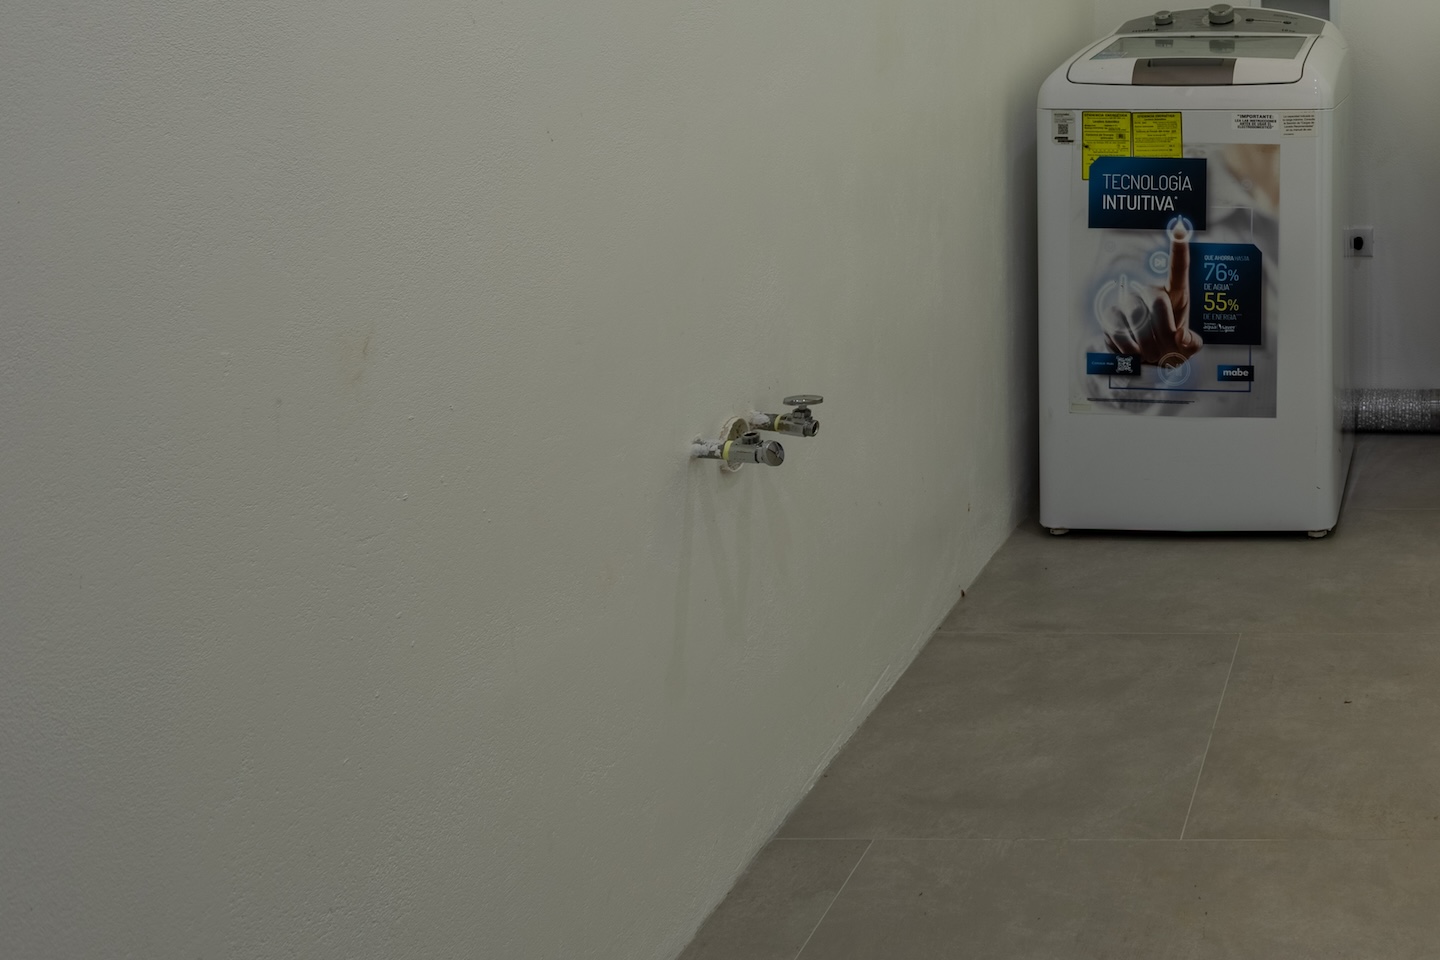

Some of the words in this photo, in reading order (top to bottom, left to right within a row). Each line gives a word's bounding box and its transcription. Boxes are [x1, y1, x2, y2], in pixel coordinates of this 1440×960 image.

[1102, 171, 1193, 191] TECNOLOGÍA
[1203, 262, 1240, 281] 76%
[1203, 292, 1240, 311] 55%
[1222, 368, 1250, 377] mabe
